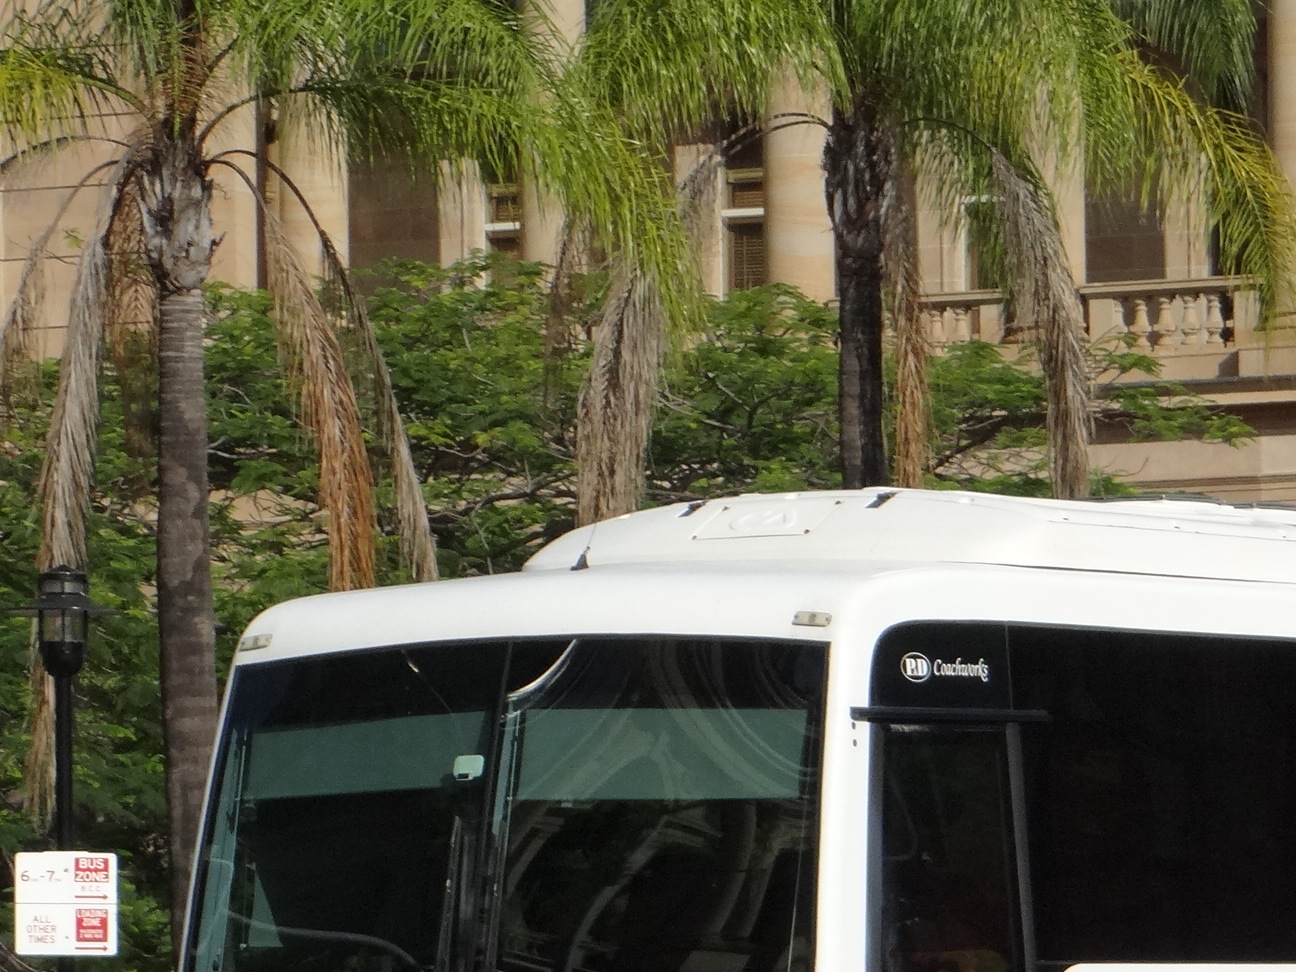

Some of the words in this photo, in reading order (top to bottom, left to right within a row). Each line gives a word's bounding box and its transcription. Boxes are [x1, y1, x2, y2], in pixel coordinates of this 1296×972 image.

[933, 657, 989, 682] Coachworks
[78, 858, 105, 869] BUS
[75, 871, 109, 882] ZONE
[32, 915, 51, 924] ALL
[26, 925, 57, 934] OTHER
[28, 934, 56, 944] TIMES
